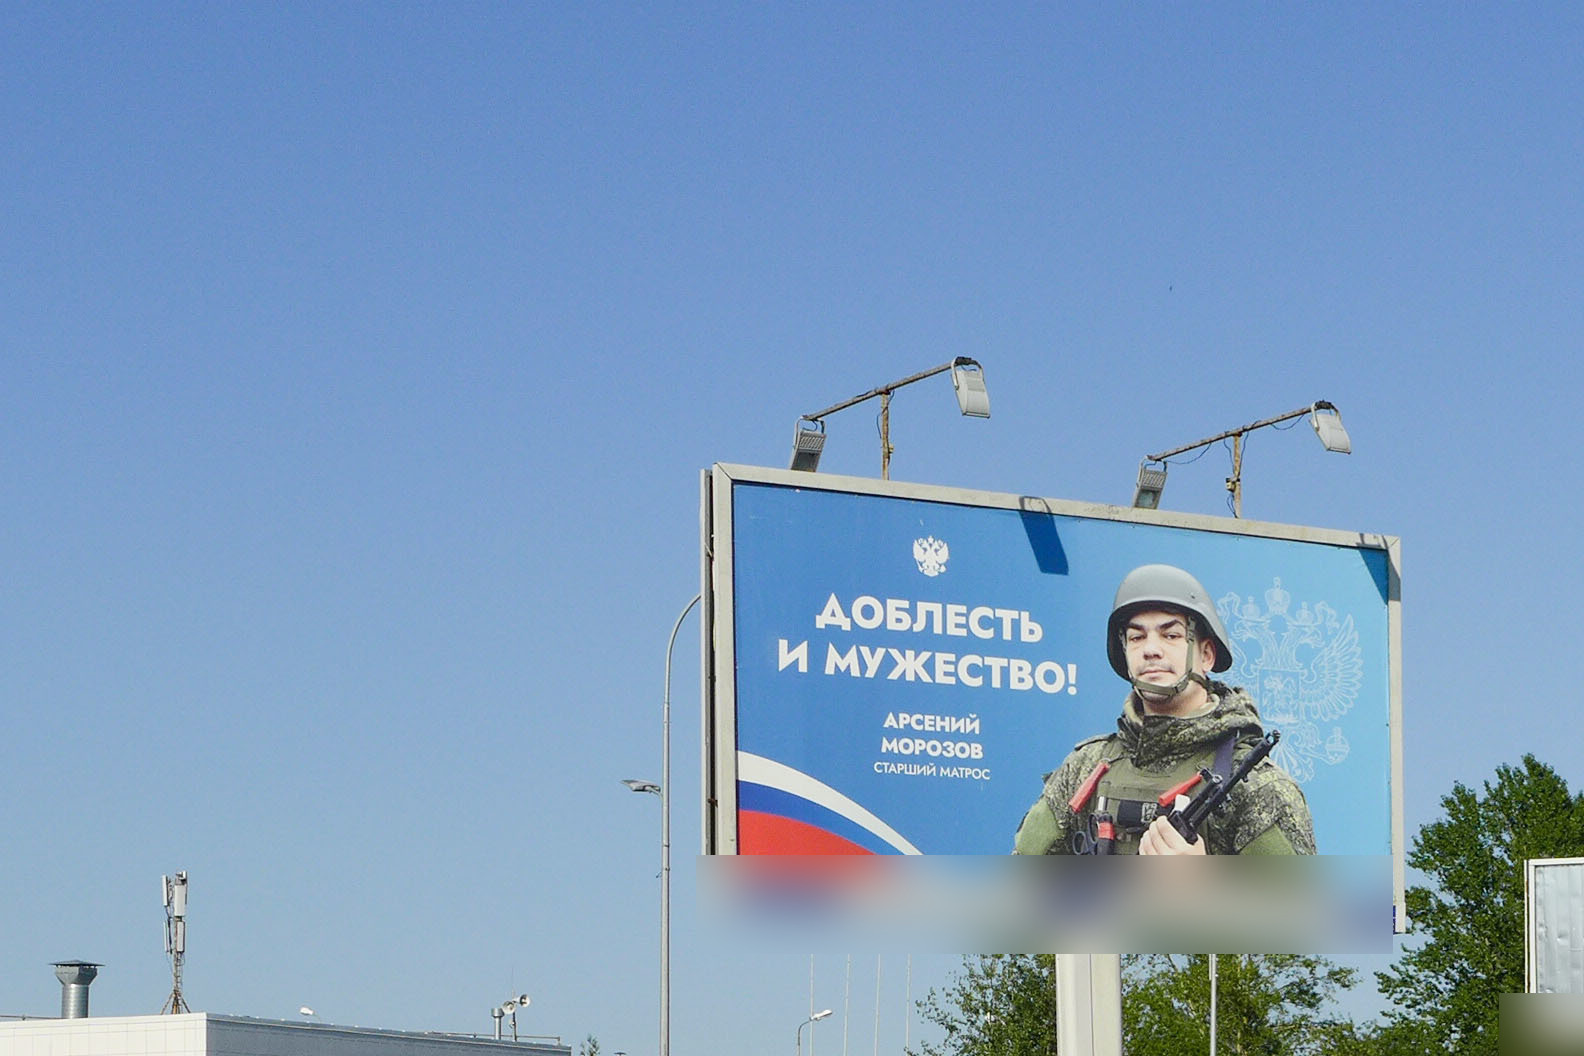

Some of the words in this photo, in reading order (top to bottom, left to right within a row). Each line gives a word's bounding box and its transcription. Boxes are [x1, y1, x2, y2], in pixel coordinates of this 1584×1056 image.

[815, 592, 1043, 643] ДОБЛЕСТЬ
[778, 639, 809, 673] И
[824, 642, 1077, 696] МУЖЕСТВО!
[883, 712, 980, 735] АРСЕНИЙ
[881, 737, 983, 759] МОРОЗОВ
[873, 761, 936, 777] СТАРШИЙ
[939, 766, 990, 780] МАТРОС
